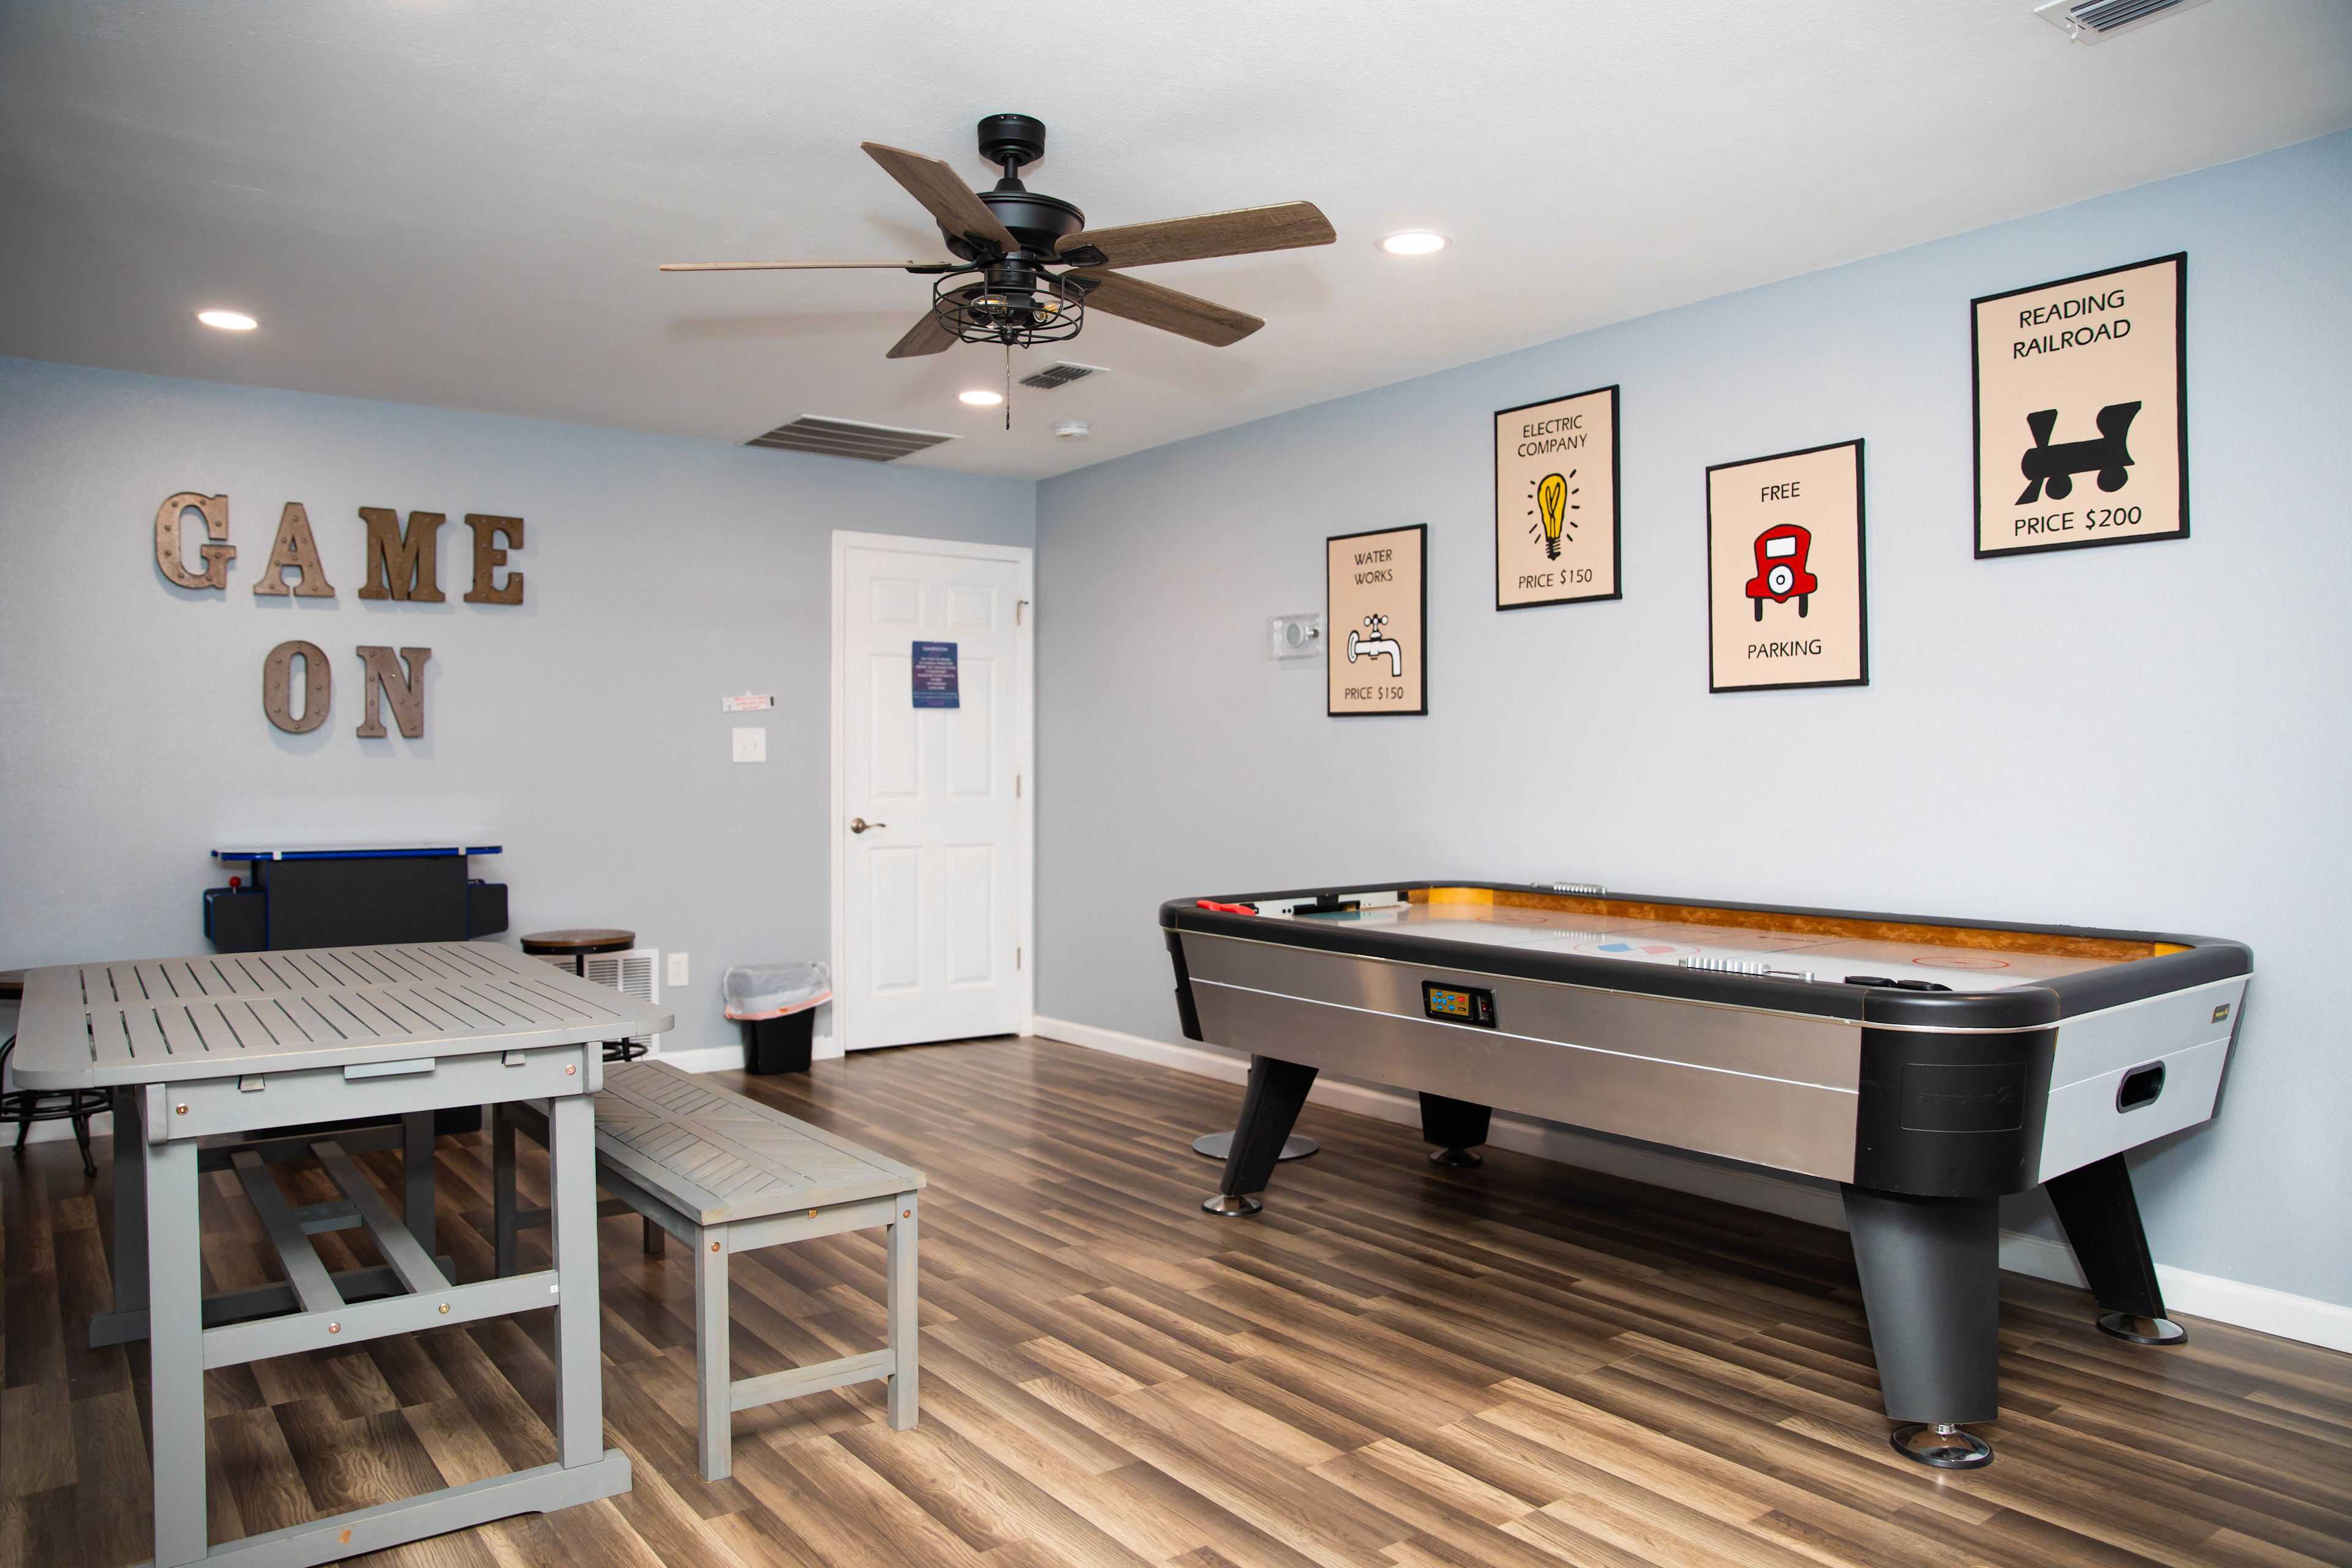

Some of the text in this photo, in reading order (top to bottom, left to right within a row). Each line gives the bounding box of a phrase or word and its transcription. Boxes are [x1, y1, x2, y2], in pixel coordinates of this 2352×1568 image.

[2019, 289, 2124, 328] READING
[2013, 319, 2131, 360] RAILROAD
[1523, 415, 1582, 438] ELECTRIC
[1518, 434, 1587, 458] COMPANY
[1762, 481, 1800, 502] FREE
[2015, 506, 2141, 537] PRICE $200
[154, 491, 524, 606] GAME
[1354, 549, 1392, 565] WATER
[1354, 568, 1393, 585] WORKS
[1519, 568, 1592, 589] PRICE $150
[1748, 639, 1822, 659] PARKING
[263, 640, 432, 739] ON
[1345, 687, 1403, 700] PRICE $150
